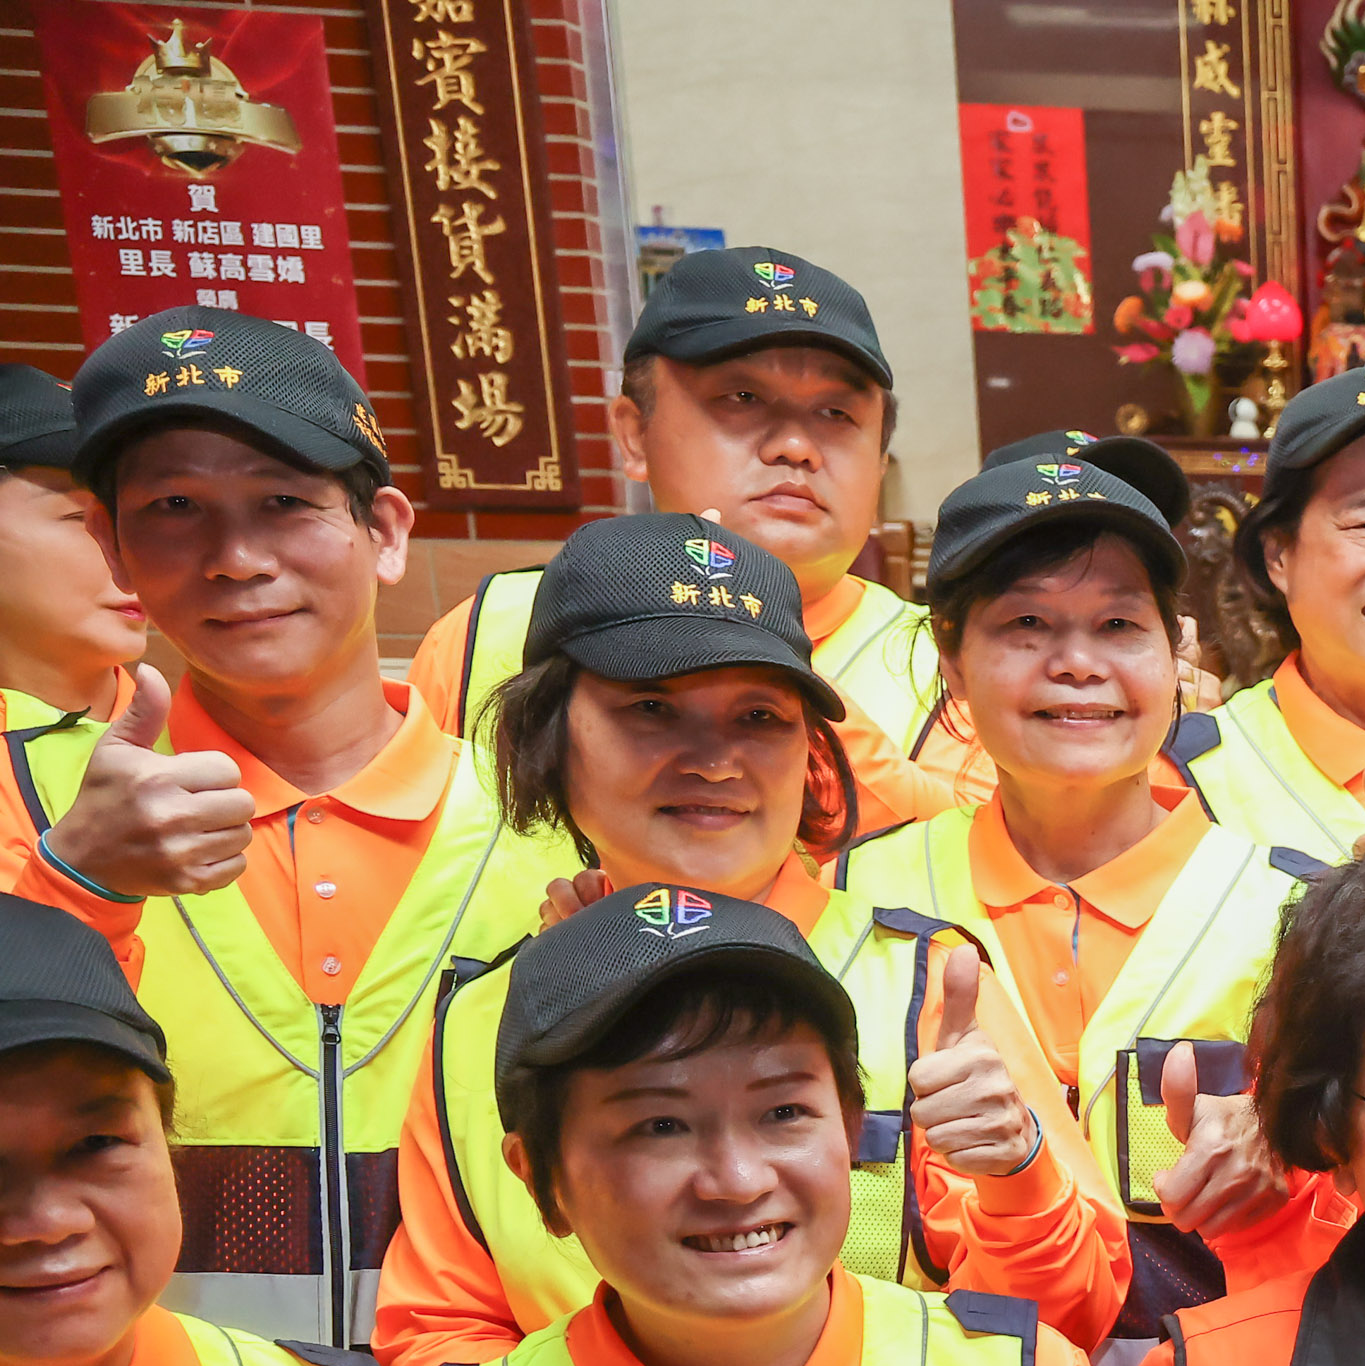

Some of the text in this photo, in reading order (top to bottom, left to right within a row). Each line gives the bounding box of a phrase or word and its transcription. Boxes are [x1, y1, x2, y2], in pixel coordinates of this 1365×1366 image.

[187, 184, 219, 213] 賀
[91, 215, 325, 250] 新北市 新店區 建國里
[119, 248, 177, 278] 里長
[745, 294, 819, 318] 新北市
[144, 363, 243, 396] 新北市
[670, 580, 763, 618] 新北市
